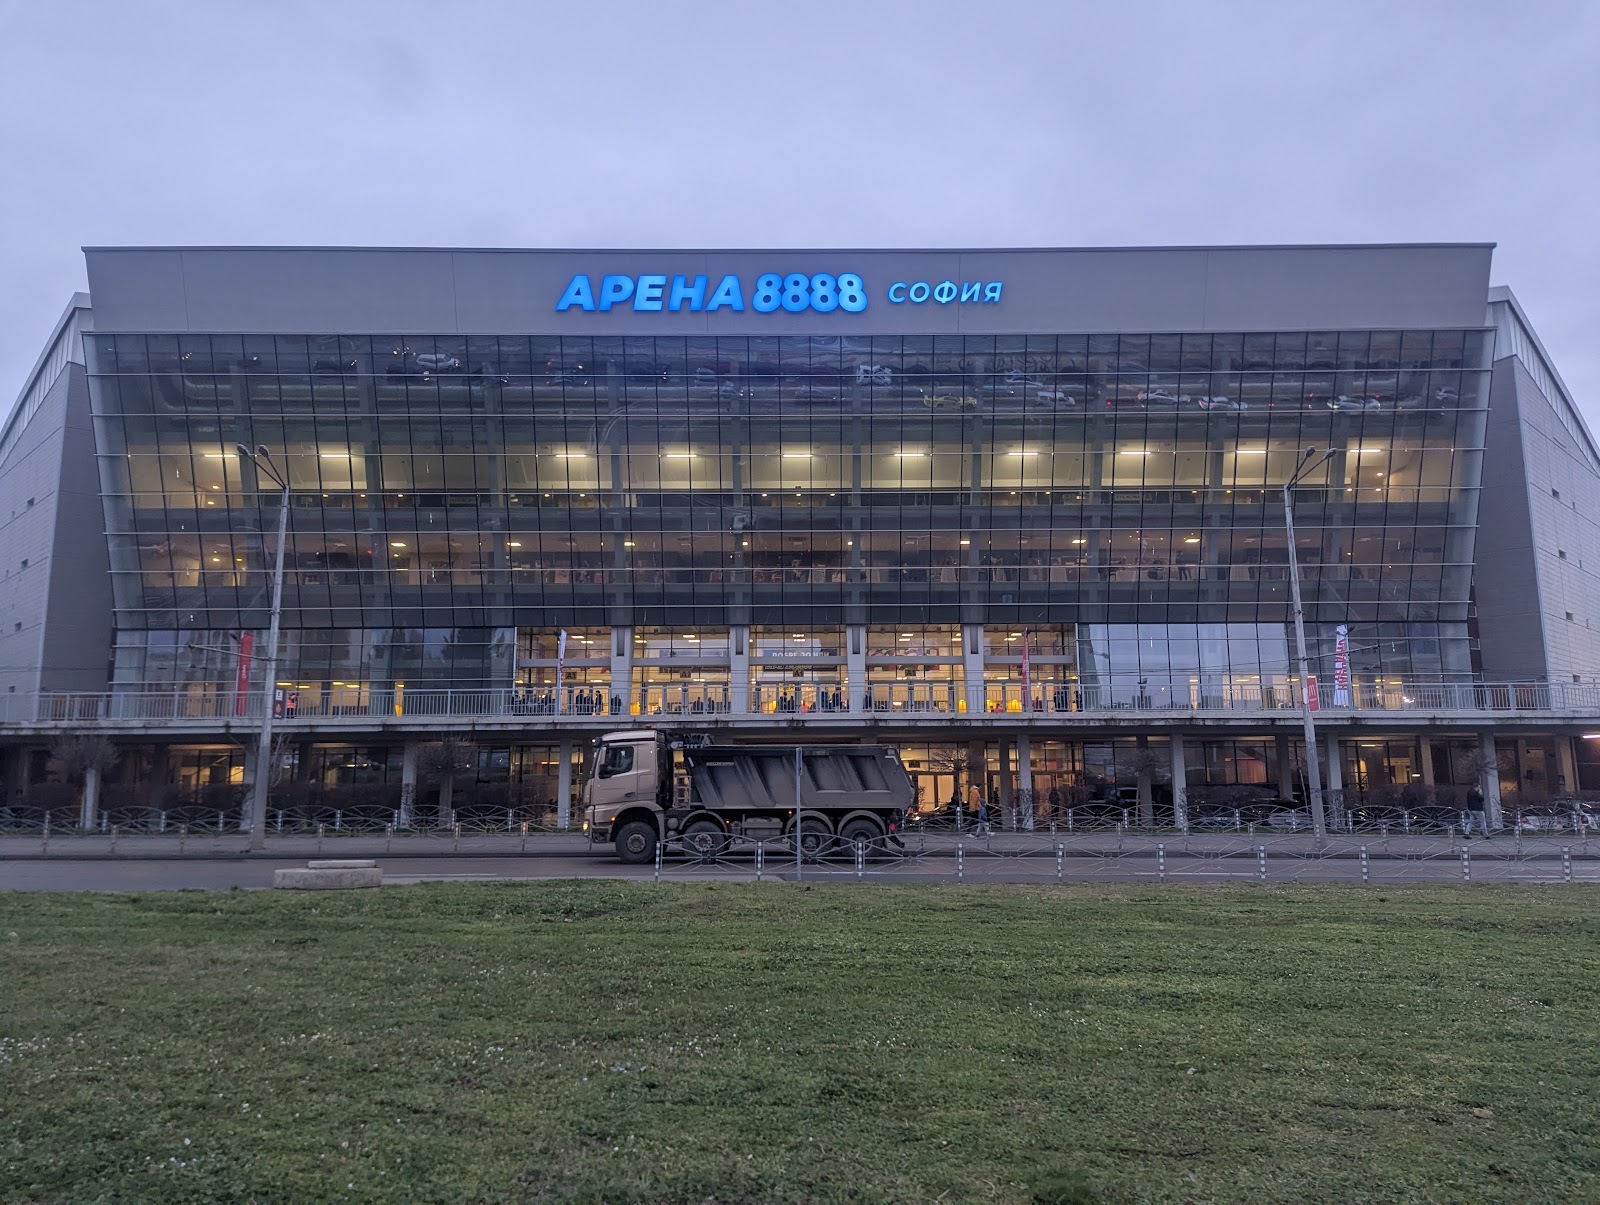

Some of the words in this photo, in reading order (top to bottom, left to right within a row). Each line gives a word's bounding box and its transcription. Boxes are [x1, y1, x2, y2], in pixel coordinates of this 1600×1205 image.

[556, 275, 745, 311] АРЕНА
[752, 273, 868, 312] 8888
[888, 280, 1003, 304] СОФИЯ
